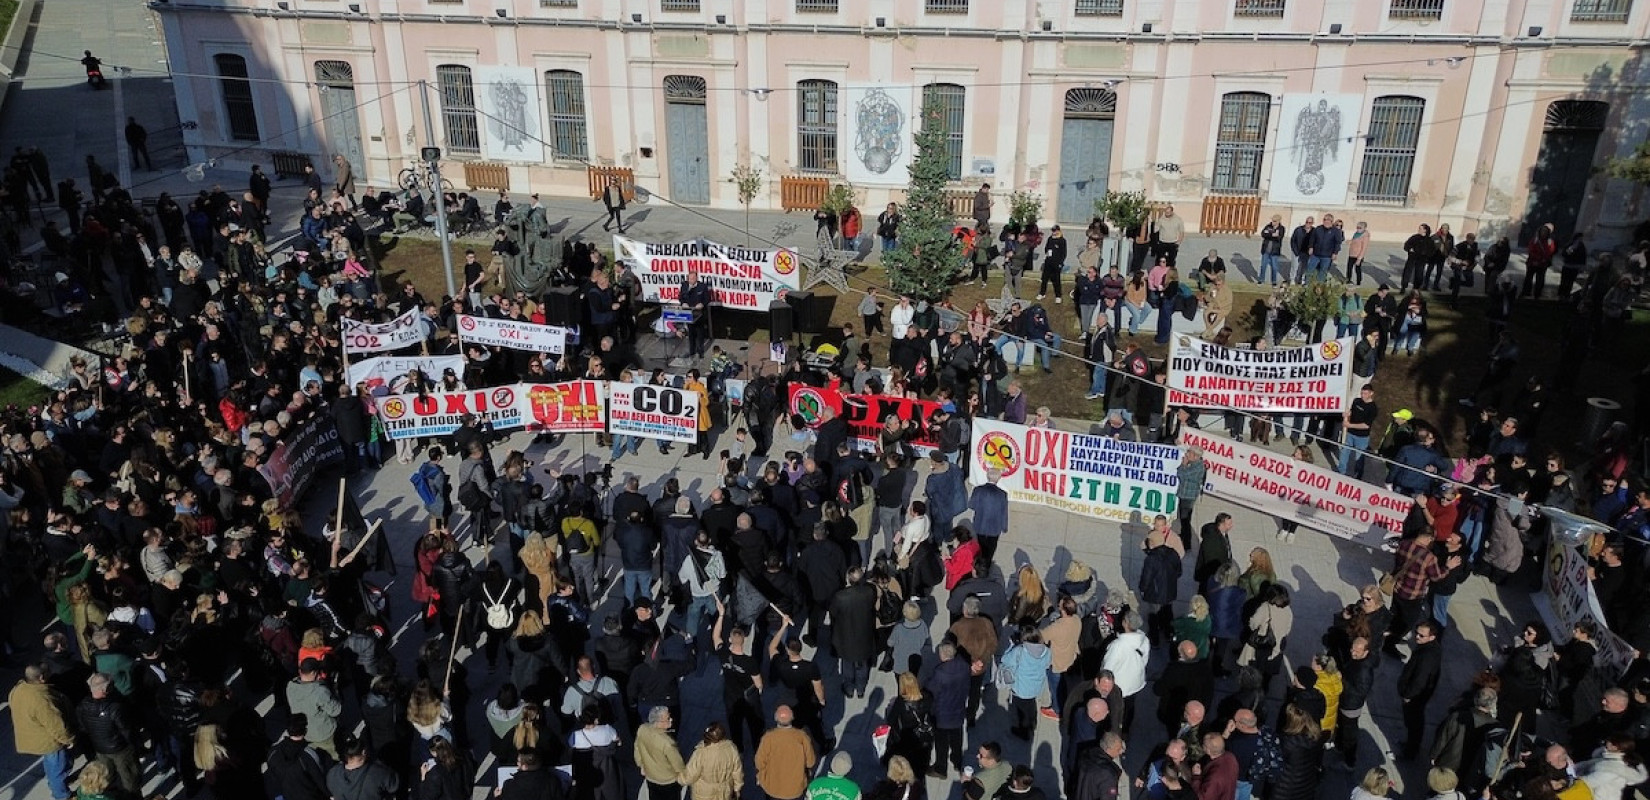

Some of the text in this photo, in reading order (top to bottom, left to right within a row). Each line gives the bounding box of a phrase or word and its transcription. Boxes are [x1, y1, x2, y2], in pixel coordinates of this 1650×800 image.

[651, 258, 683, 273] ΟΛΟΙ
[687, 259, 713, 274] ΜΙΑ
[718, 277, 751, 292] ΝΟΜΟΥ
[754, 282, 773, 293] ΜΑΣ
[730, 291, 757, 307] ΧΩΡΑ
[499, 328, 520, 340] ΟΧΙ
[1201, 343, 1230, 361] ΕΝΑ
[1233, 347, 1314, 363] ΣΥΝΘΗΜΑ
[1172, 357, 1343, 379] ΠΟΥ ΟΛΟΥΣ ΜΑΣ ΕΝΩΝΕΙ
[1185, 375, 1327, 394] Η ΑΝΑΠΤΥΞΗ ΣΑΣ ΤΟ
[413, 391, 489, 416] ΟΧΙ
[530, 382, 599, 424] ΟΧΙ
[1169, 390, 1341, 409] ΜΕΛΛΟΝ ΜΑΣ ΣΚΟΤΩΝΕΙ
[1025, 429, 1179, 470] ΟΧΙ ΣΤΗΝ ΑΠΟΘΗΚΕΥΣΗ
[1071, 447, 1164, 471] ΚΑΥΣΑΕΡΙΩΝ ΣΤΑ
[1069, 459, 1178, 487] ΣΠΛΑΧΝΑ ΤΗΣ ΘΑΣΟ
[1183, 432, 1235, 459] ΚΑΒΑΛΑ
[1249, 452, 1294, 479] ΘΑΣΟΣ
[1297, 468, 1332, 491] ΟΛΟΙ
[1335, 481, 1362, 502] ΜΙΑ
[1368, 493, 1413, 514] ΦΩΝΗ
[1024, 468, 1068, 496] ΝΑΙ
[1069, 476, 1121, 505] ΣΤΗ
[1239, 471, 1250, 486] Η
[1251, 474, 1312, 508] ΧΑΒΟΥΖΑ
[1315, 497, 1346, 515] ΑΠΟ
[1350, 506, 1370, 523] ΤΟ
[1373, 511, 1405, 534] ΝΗΣ
